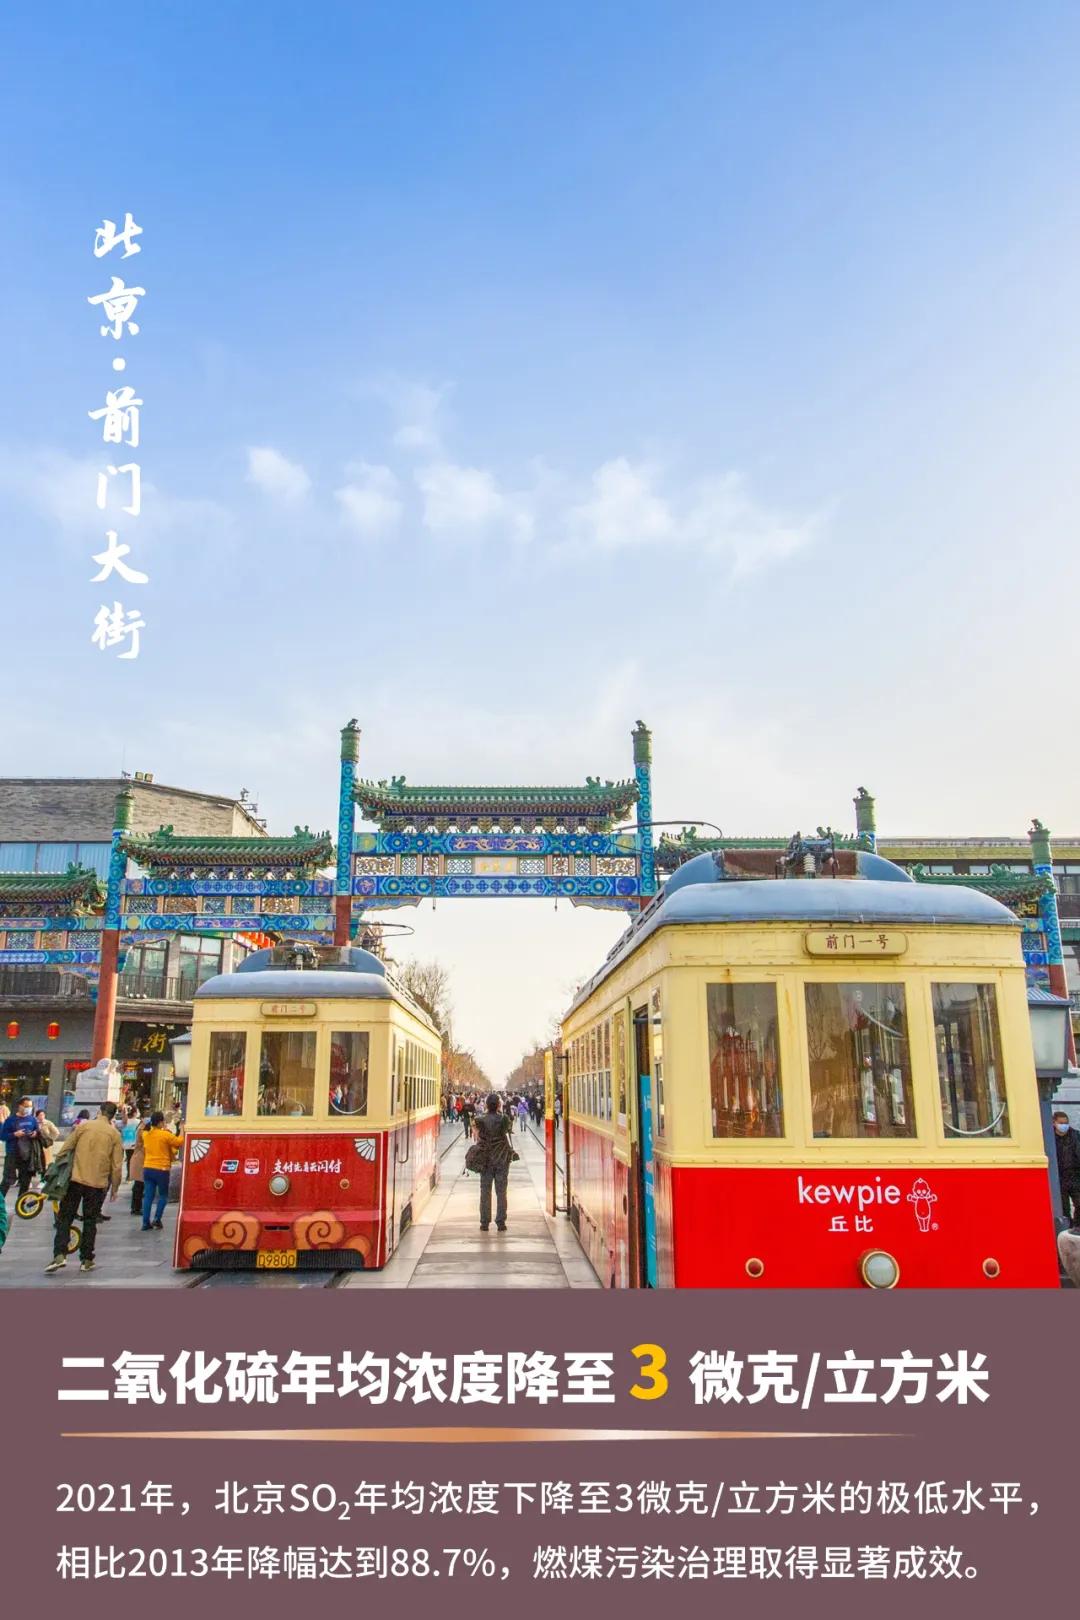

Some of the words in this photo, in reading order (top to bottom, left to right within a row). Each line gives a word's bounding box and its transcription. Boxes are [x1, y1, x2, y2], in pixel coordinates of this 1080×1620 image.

[825, 933, 889, 950] 前门一号
[797, 1175, 901, 1212] kewpie
[827, 1214, 874, 1232] 丘比
